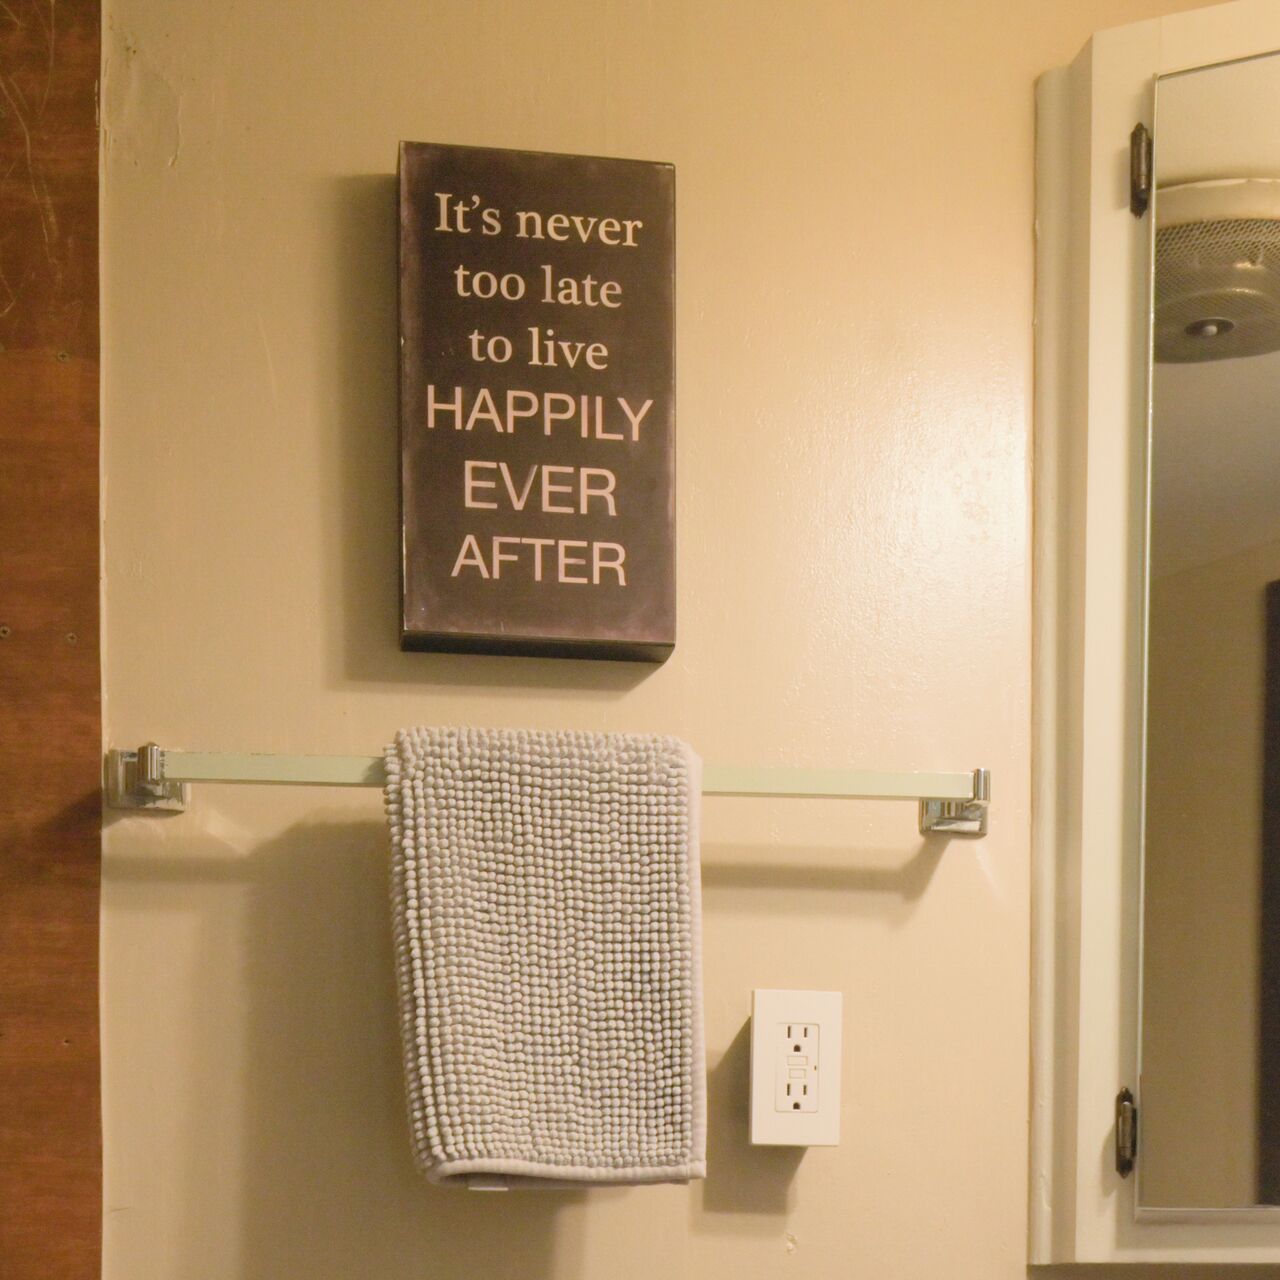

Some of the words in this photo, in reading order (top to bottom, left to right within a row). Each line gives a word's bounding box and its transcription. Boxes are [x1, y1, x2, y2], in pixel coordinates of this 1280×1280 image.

[434, 192, 502, 236] It’s
[516, 210, 643, 248] never
[454, 263, 526, 301] too
[541, 264, 622, 308] late
[468, 328, 513, 363] to
[527, 326, 609, 370] live
[426, 384, 654, 442] HAPPILY
[464, 459, 618, 517] EVER
[450, 534, 627, 587] AFTER
